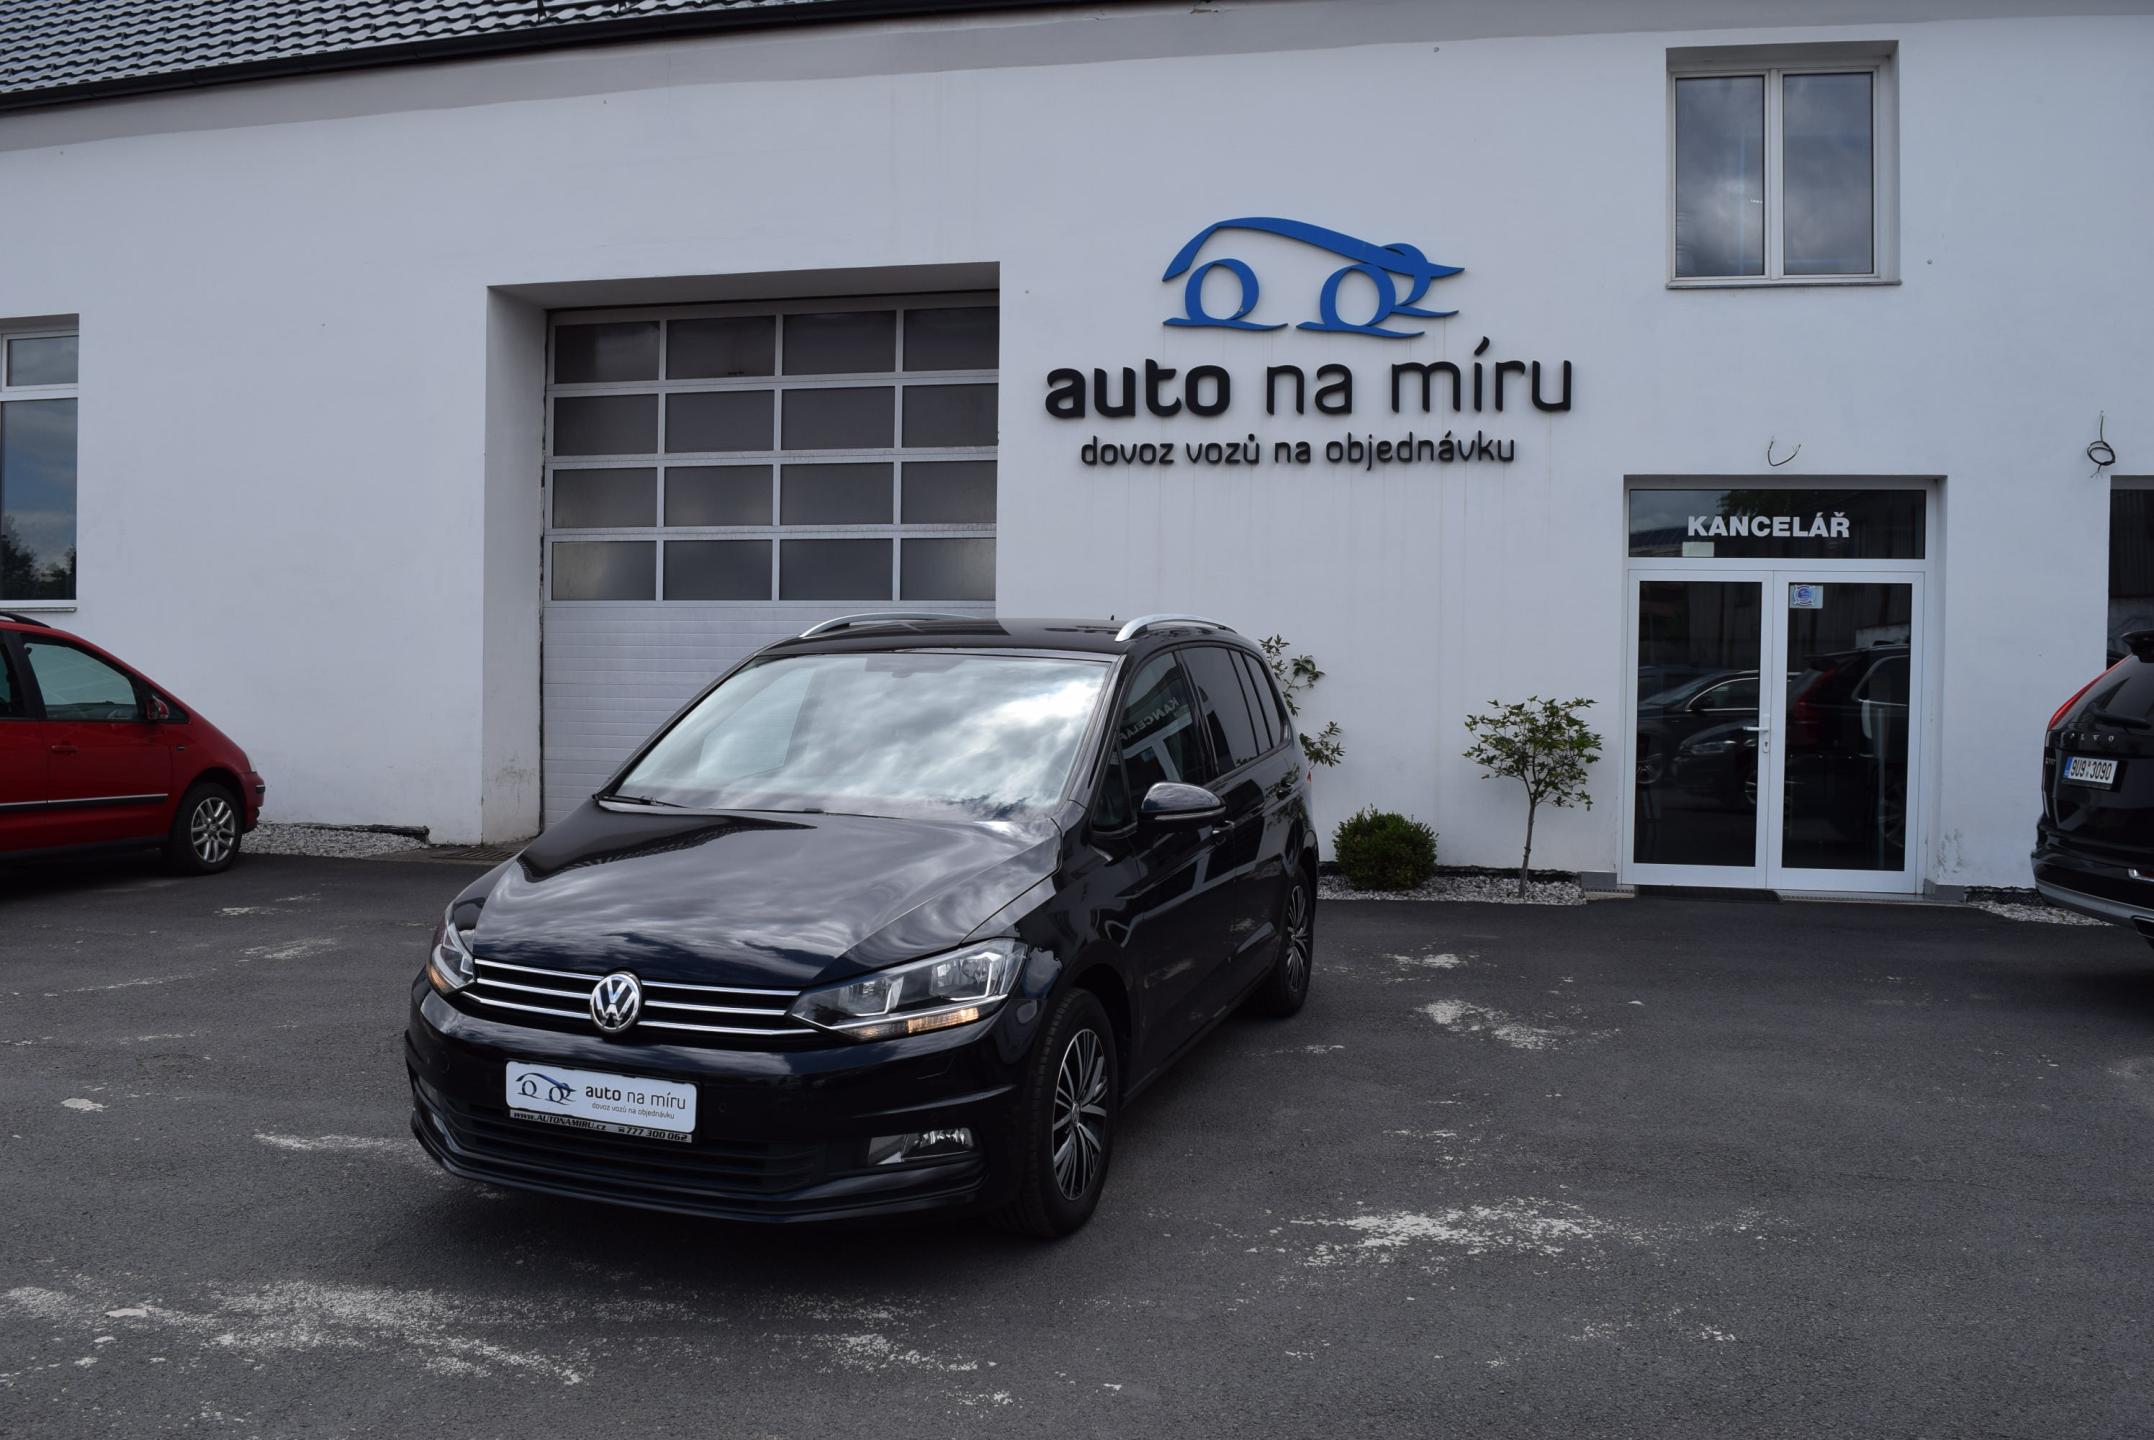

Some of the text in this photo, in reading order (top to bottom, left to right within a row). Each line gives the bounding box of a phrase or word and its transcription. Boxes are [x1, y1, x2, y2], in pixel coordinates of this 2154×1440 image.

[1045, 336, 1572, 418] auto na míru
[1081, 430, 1515, 471] dovoz vozů na objednávku
[1687, 512, 1850, 538] KANCELÁŘ
[2070, 759, 2087, 777] 9U9
[2089, 761, 2113, 780] 3090
[585, 1085, 686, 1110] auto na míru
[592, 1102, 611, 1111] dovoz
[628, 1107, 637, 1115] na
[626, 1126, 644, 1136] 777
[646, 1129, 665, 1139] 300
